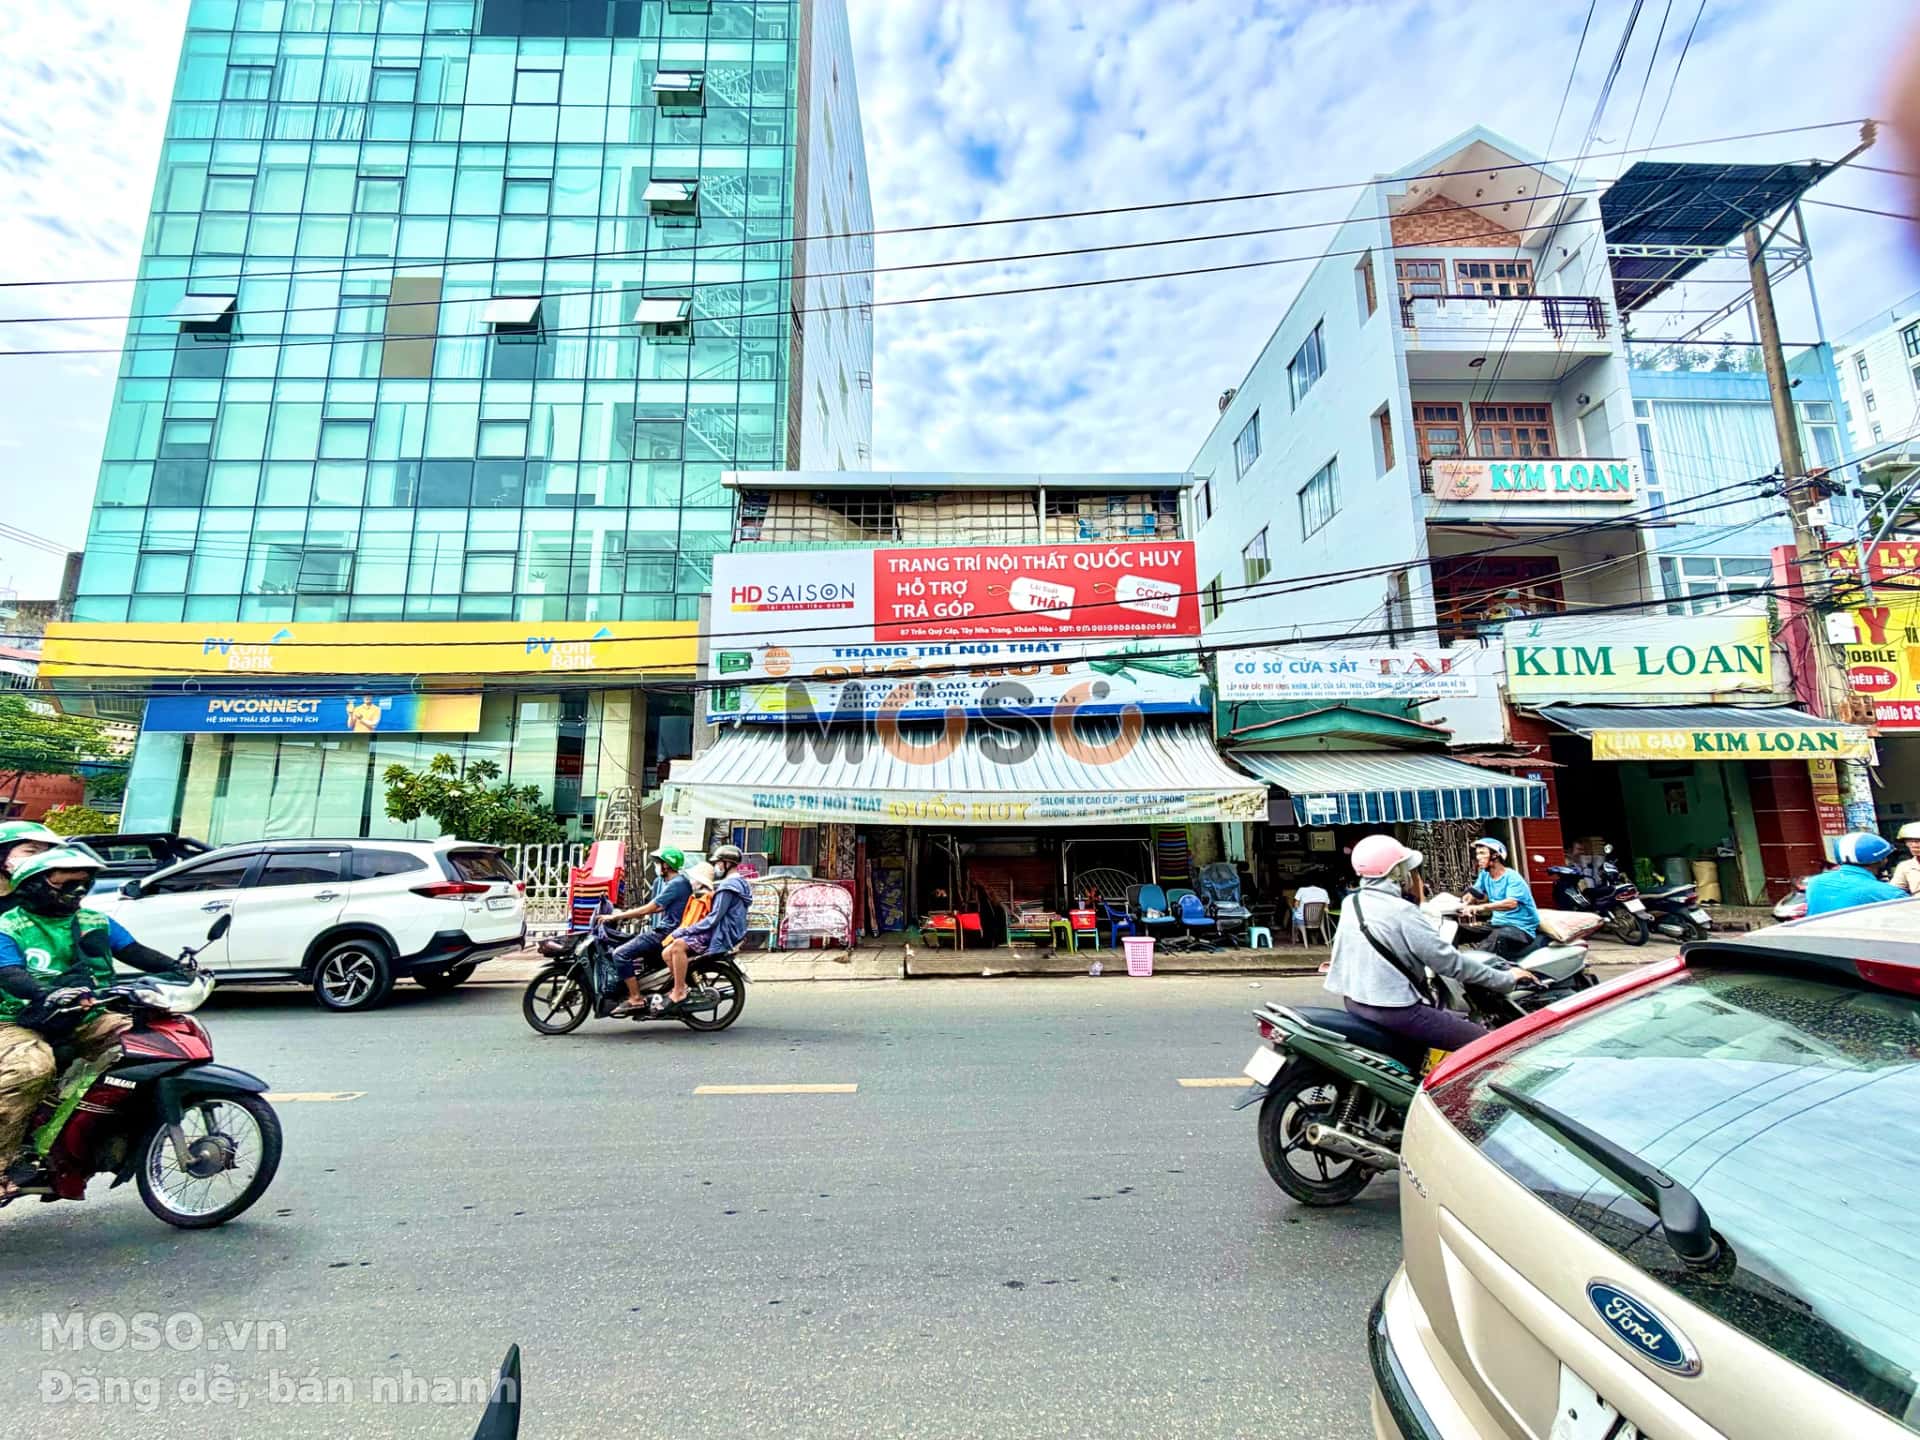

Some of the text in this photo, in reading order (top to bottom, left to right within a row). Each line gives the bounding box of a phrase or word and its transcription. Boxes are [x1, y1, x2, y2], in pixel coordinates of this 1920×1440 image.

[1487, 463, 1546, 492] KIM
[1551, 463, 1631, 492] LOAN
[888, 546, 1183, 574] TRANG TRÍ NỘI THẤT QUỐC HUY
[731, 582, 855, 603] HD SAISON
[897, 577, 968, 598] HỖ TRỢ
[892, 600, 975, 618] TRẢ GÓP
[832, 647, 908, 657] TRANG
[916, 642, 951, 656] TRÍ
[960, 642, 998, 655] NỘI
[1848, 650, 1896, 662] OBILE
[552, 655, 597, 671] Bank
[1234, 661, 1256, 674] CƠ
[1330, 655, 1359, 673] SẮT
[1512, 645, 1765, 676] KIM LOAN
[937, 682, 966, 691] CAO
[208, 699, 322, 713] PVCONNECT
[1875, 705, 1900, 721] obile
[240, 715, 258, 723] THÁI
[1692, 732, 1749, 752] KIM
[1757, 732, 1839, 752] LOAN
[752, 793, 795, 809] TRANG
[972, 802, 1031, 820] HUY
[1086, 797, 1101, 805] CAO
[104, 1075, 136, 1090] YAMAHA
[1605, 1297, 1663, 1350] Ford
